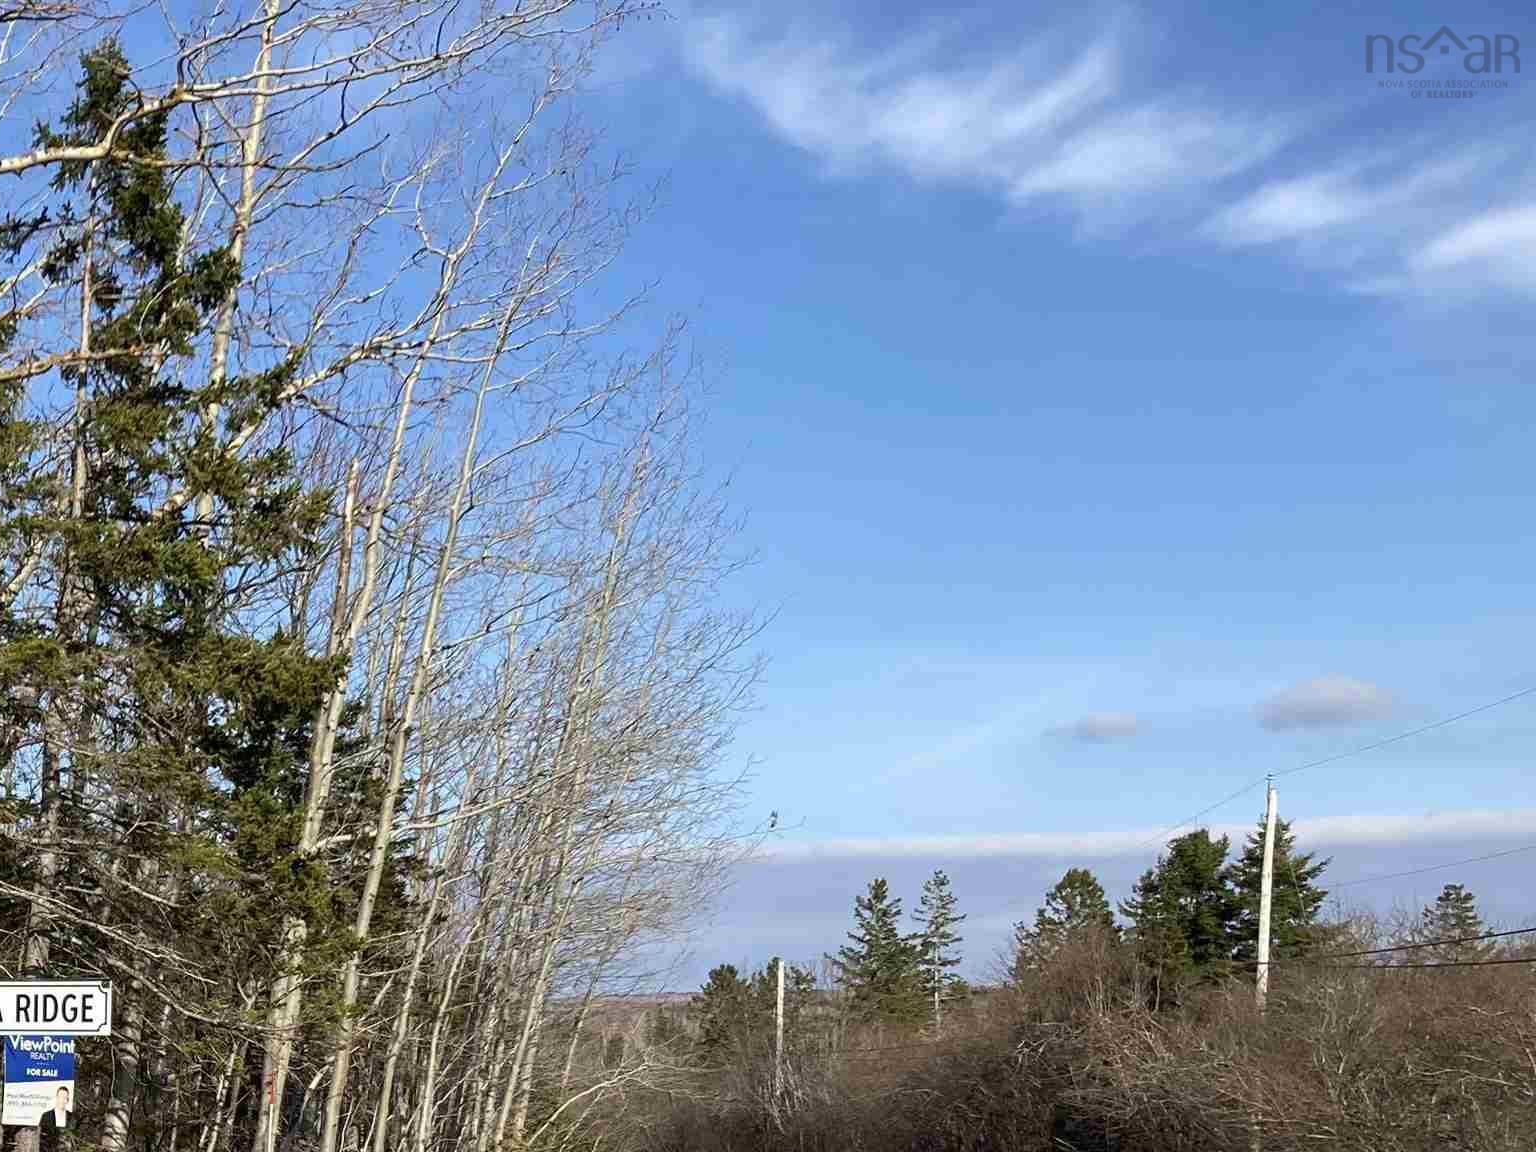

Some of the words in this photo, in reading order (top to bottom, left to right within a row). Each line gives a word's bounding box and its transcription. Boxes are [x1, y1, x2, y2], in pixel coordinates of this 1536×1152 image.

[15, 993, 94, 1023] RIDGE
[9, 1034, 75, 1053] ViewPoint
[30, 1051, 55, 1060] REALTY
[26, 1067, 41, 1076] FOR
[42, 1068, 58, 1077] SALE
